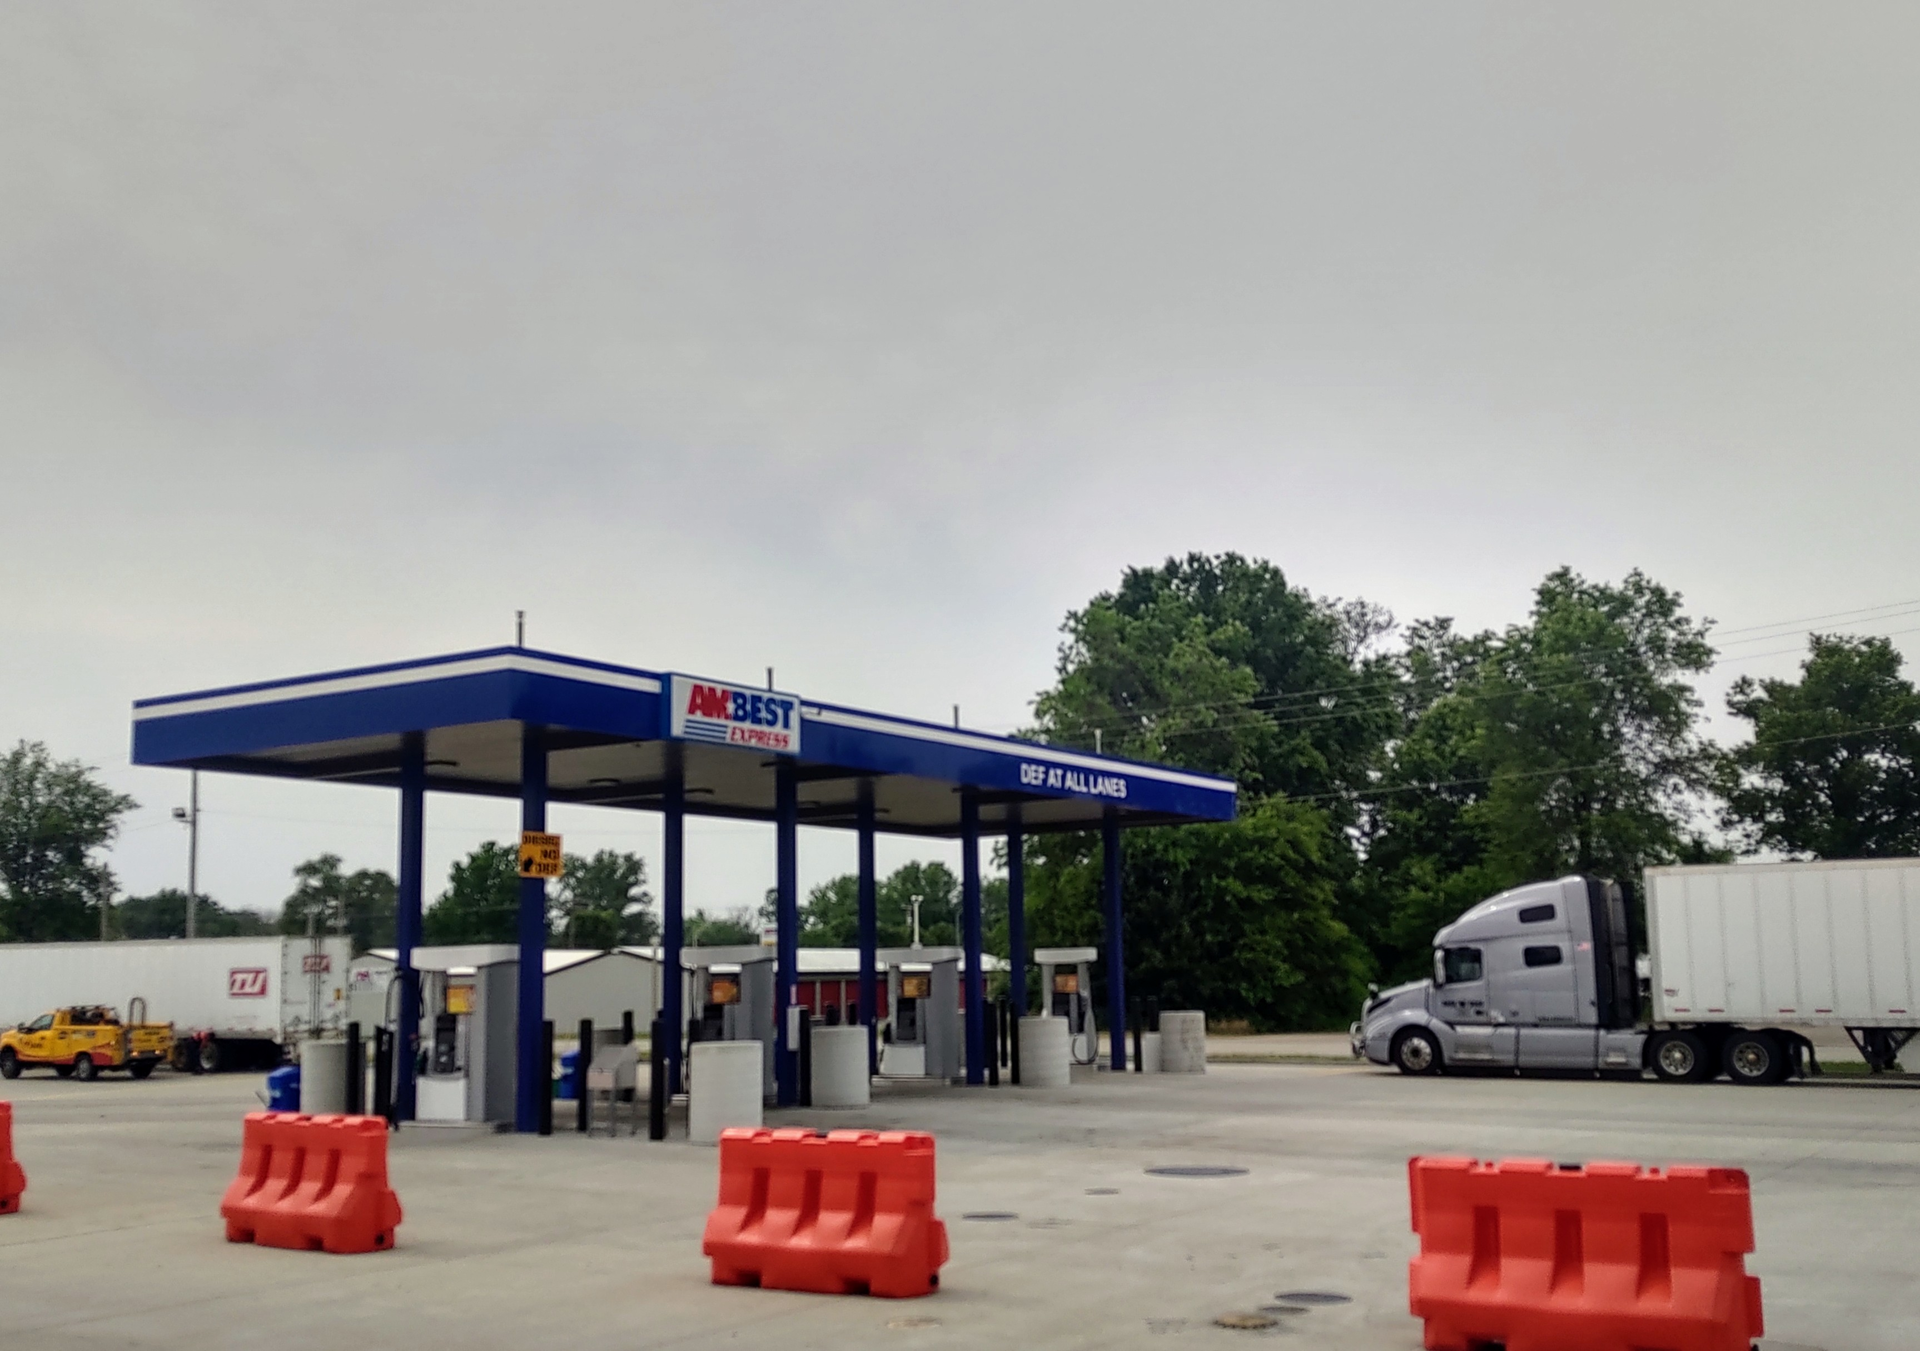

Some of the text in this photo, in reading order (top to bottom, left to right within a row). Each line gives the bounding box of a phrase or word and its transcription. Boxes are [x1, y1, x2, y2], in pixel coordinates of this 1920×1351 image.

[730, 726, 790, 748] EXPRESS
[1020, 763, 1127, 799] DEF AT ALL LANES
